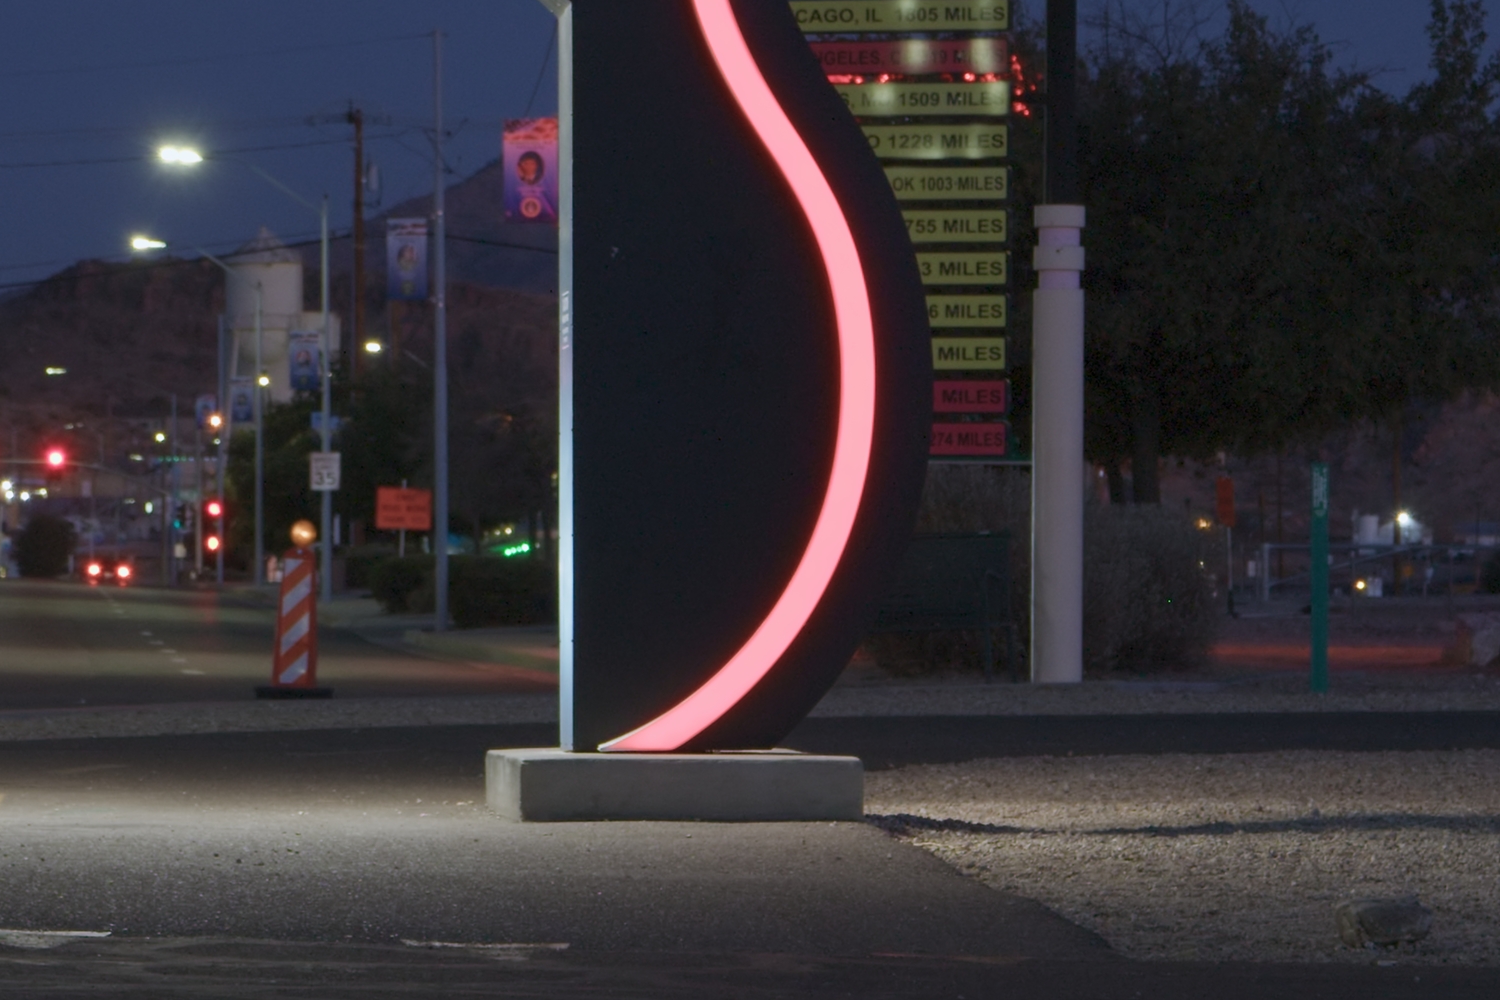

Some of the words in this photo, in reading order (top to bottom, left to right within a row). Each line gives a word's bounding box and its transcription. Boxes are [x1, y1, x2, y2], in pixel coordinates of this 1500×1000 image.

[865, 8, 883, 22] IL
[945, 6, 1006, 21] MILES
[899, 92, 940, 107] 1509
[946, 92, 1007, 106] MILES
[888, 134, 934, 149] 1228
[941, 133, 1004, 149] MILES
[892, 177, 915, 192] OK
[920, 177, 953, 191] 1003
[958, 176, 1004, 191] MILES
[943, 218, 1004, 234] MILES
[939, 261, 1003, 276] MILES
[945, 304, 1003, 318] MILES
[937, 346, 1002, 361] MILES
[942, 389, 1001, 404] MILES
[958, 432, 1003, 447] MILES
[315, 471, 336, 486] 35
